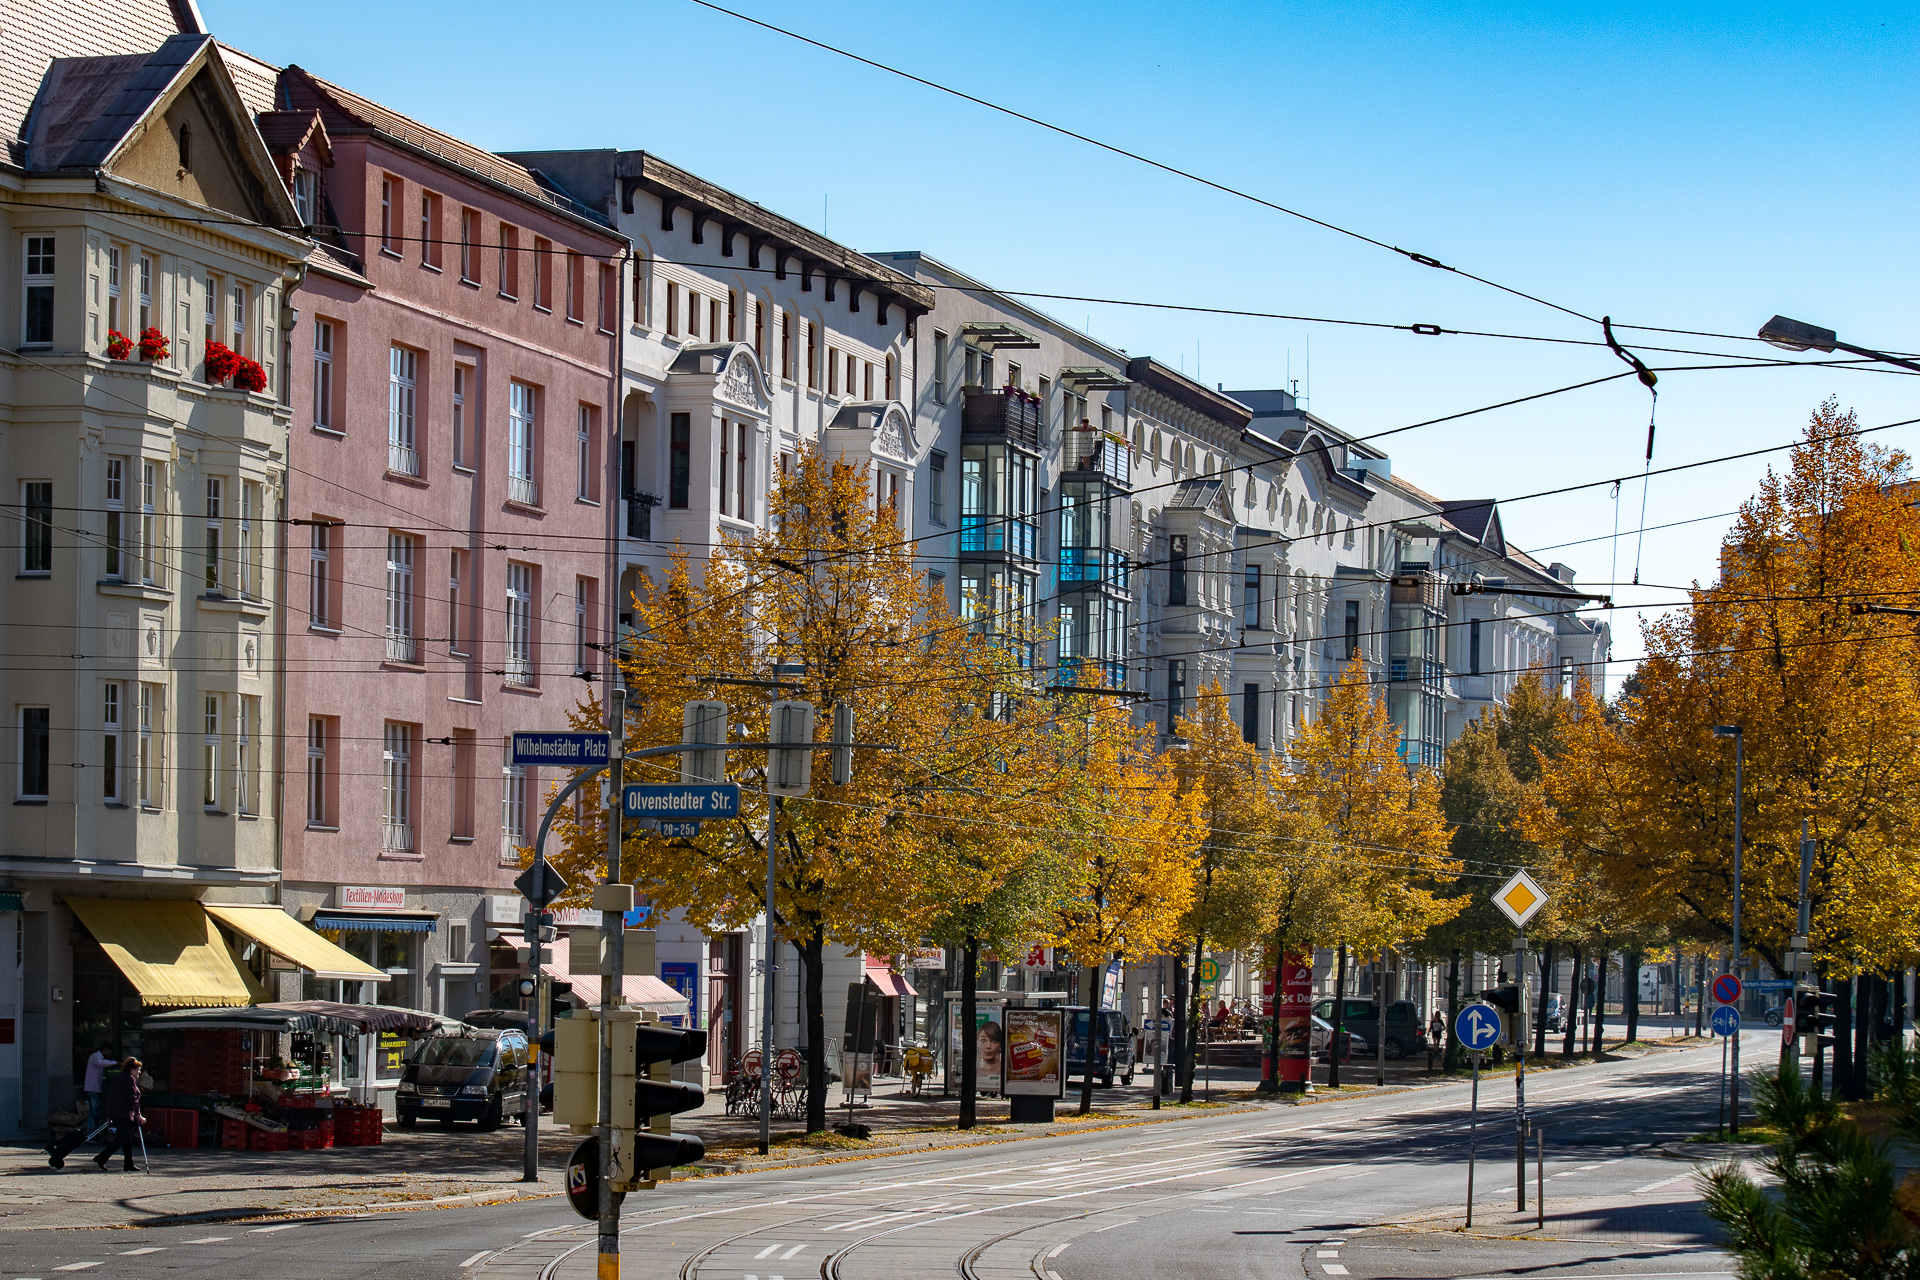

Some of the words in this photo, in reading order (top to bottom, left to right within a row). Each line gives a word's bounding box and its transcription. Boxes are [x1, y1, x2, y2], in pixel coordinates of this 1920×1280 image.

[516, 738, 581, 756] Wilhelmstädter
[584, 738, 607, 757] Platz
[629, 791, 705, 810] Olvenstedter
[711, 791, 732, 810] Str.
[346, 888, 404, 906] Textilien-Modeshop
[1203, 964, 1213, 978] H
